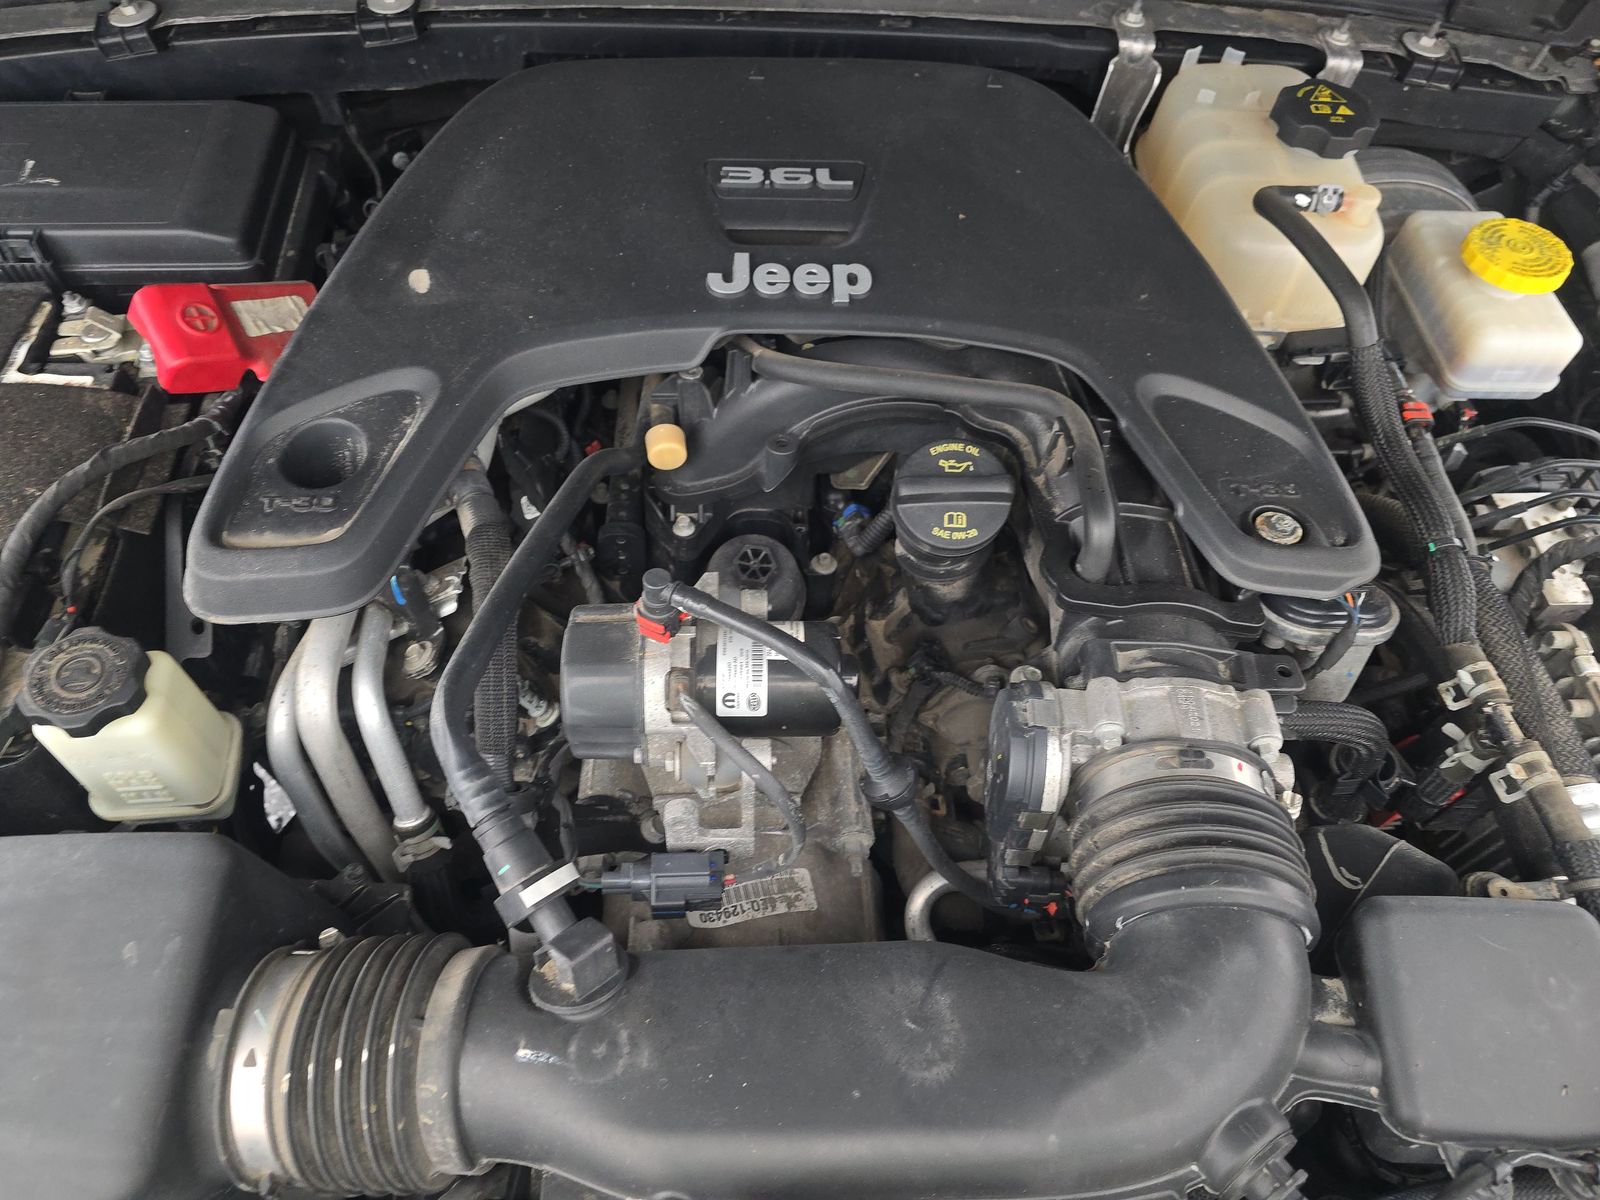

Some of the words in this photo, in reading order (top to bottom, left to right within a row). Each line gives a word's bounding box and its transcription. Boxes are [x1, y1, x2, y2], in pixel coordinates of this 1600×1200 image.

[718, 166, 854, 190] 3.6L
[706, 252, 873, 307] Jeep
[929, 443, 965, 456] ENGINE
[965, 445, 980, 456] OIL
[931, 527, 952, 539] SAE
[952, 528, 978, 540] 0W-20
